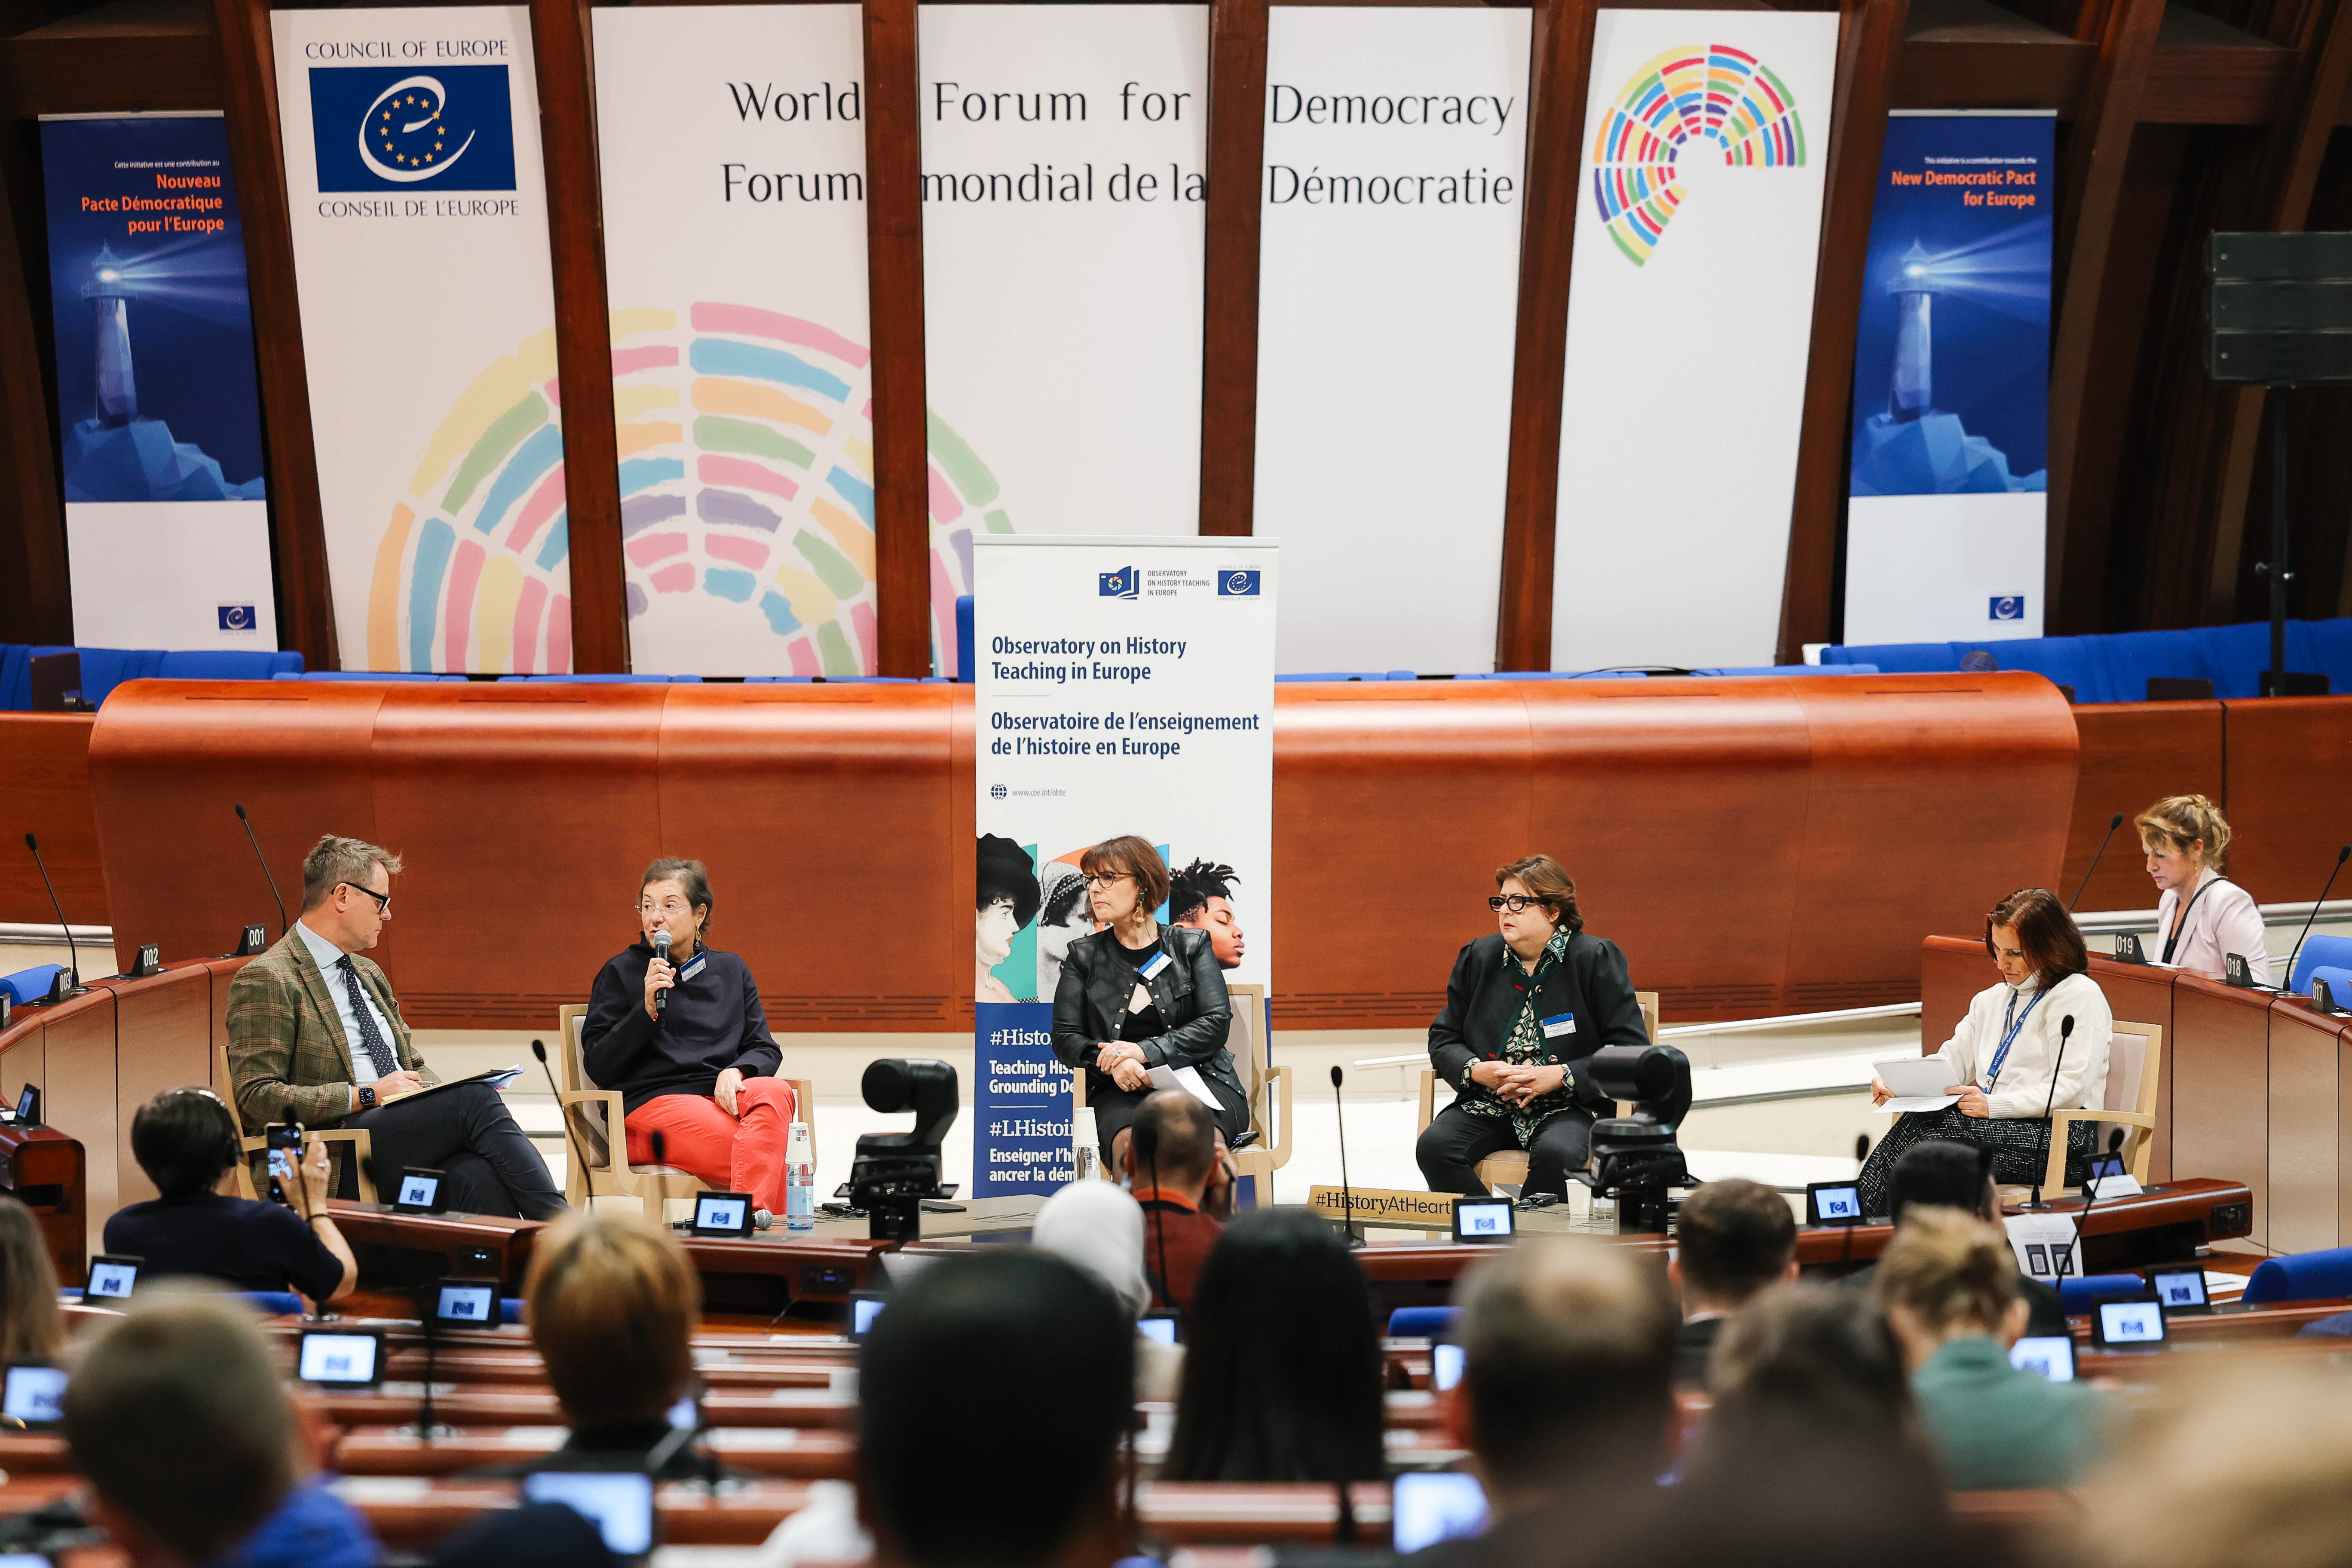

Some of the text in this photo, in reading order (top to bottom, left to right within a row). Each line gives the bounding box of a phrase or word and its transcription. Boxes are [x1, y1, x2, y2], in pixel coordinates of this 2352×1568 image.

[306, 40, 508, 59] COUNCIL OF EUROPE
[726, 82, 1514, 135] World Forum for Democracy
[157, 174, 220, 188] Nouveau
[720, 163, 1513, 204] Forum mondial de la Démocratie
[1892, 170, 2036, 185] New Democratic Pact
[82, 194, 222, 213] Pacte Démocratique
[318, 199, 520, 218] CONSEIL DE L'EUROPE
[1963, 191, 2036, 209] for Europe
[129, 217, 224, 236] pour l'Europe
[992, 637, 1186, 659] Observatory on History
[992, 662, 1151, 684] Teaching in Europe
[992, 712, 1259, 734] Observatoire de l'enseignement
[992, 737, 1180, 759] de l'histoire en Europe
[249, 928, 263, 946] 001
[2117, 936, 2133, 954] 019
[144, 948, 158, 966] 002
[2227, 958, 2241, 977] 018
[59, 972, 70, 992] 003
[2313, 982, 2323, 1001] 017
[990, 1028, 1052, 1045] #Histo
[1997, 1043, 2009, 1060] Presidency
[989, 1060, 1046, 1078] Teaching
[989, 1079, 1057, 1097] Grounding
[990, 1148, 1053, 1166] Enseigner
[989, 1170, 1031, 1182] ancrer
[1034, 1167, 1045, 1182] la
[1315, 1191, 1451, 1215] #HistoryAtHeart
